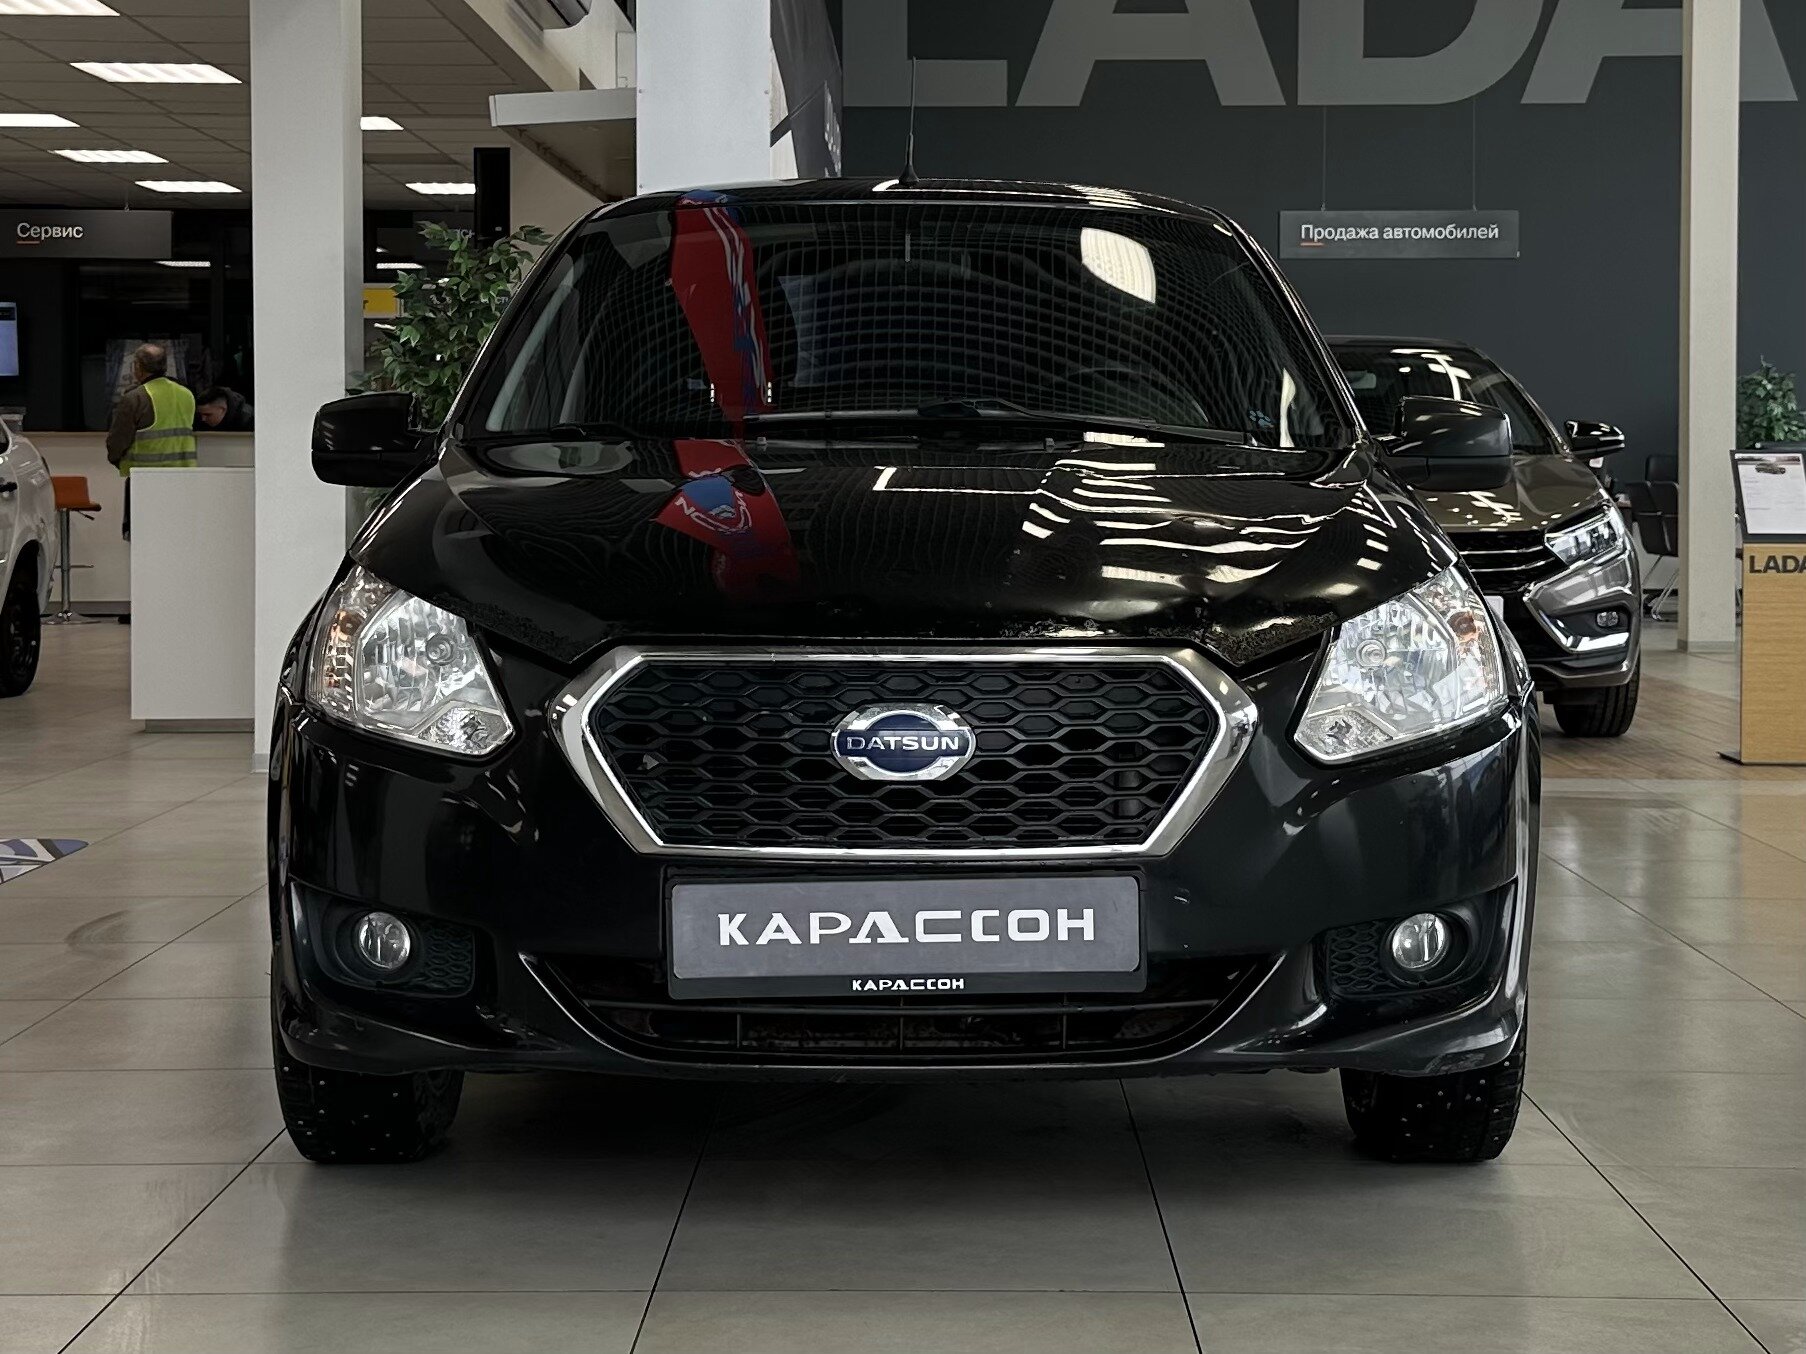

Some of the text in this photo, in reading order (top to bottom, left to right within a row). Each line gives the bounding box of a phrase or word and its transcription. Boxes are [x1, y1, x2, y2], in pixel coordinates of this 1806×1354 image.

[16, 222, 84, 240] Сервис
[1301, 223, 1499, 242] Продажа автомобилей
[846, 736, 959, 750] DATSUN
